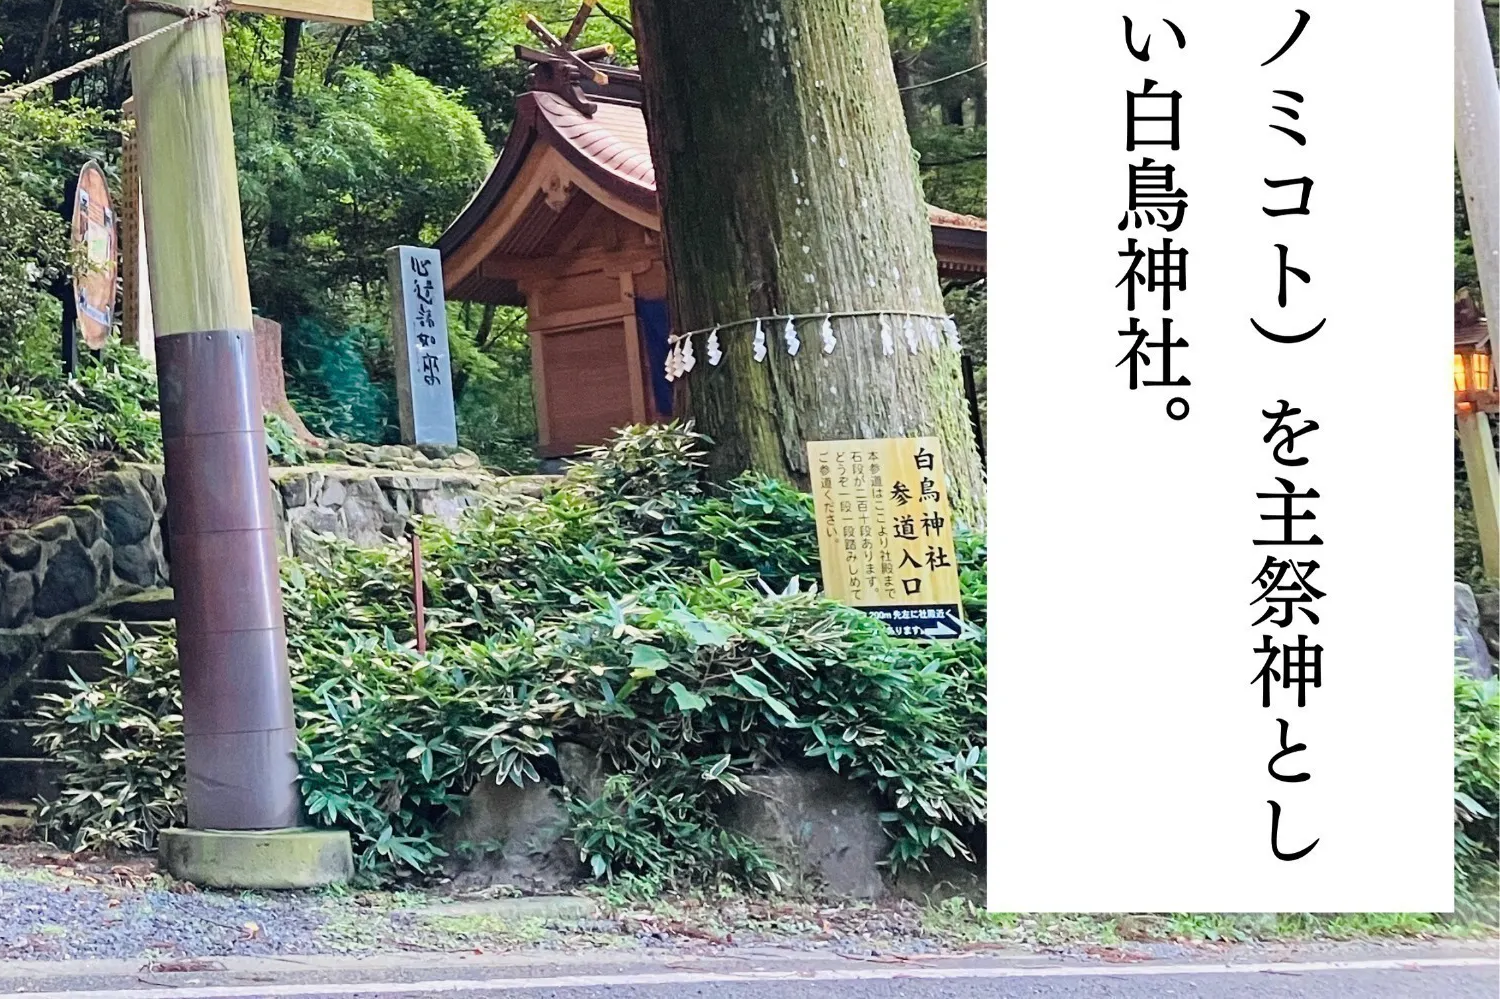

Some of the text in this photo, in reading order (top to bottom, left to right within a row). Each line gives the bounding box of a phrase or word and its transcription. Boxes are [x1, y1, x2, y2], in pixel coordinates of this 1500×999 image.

[818, 451, 840, 544] ご参道ください。
[835, 451, 862, 600] どうぞ一段一段踏みしめて
[850, 451, 880, 594] 石段が二百十段あります。
[868, 451, 897, 600] 本参道はここより社殿まで
[890, 480, 922, 597] 参道入口
[913, 447, 952, 572] 白鳥神社
